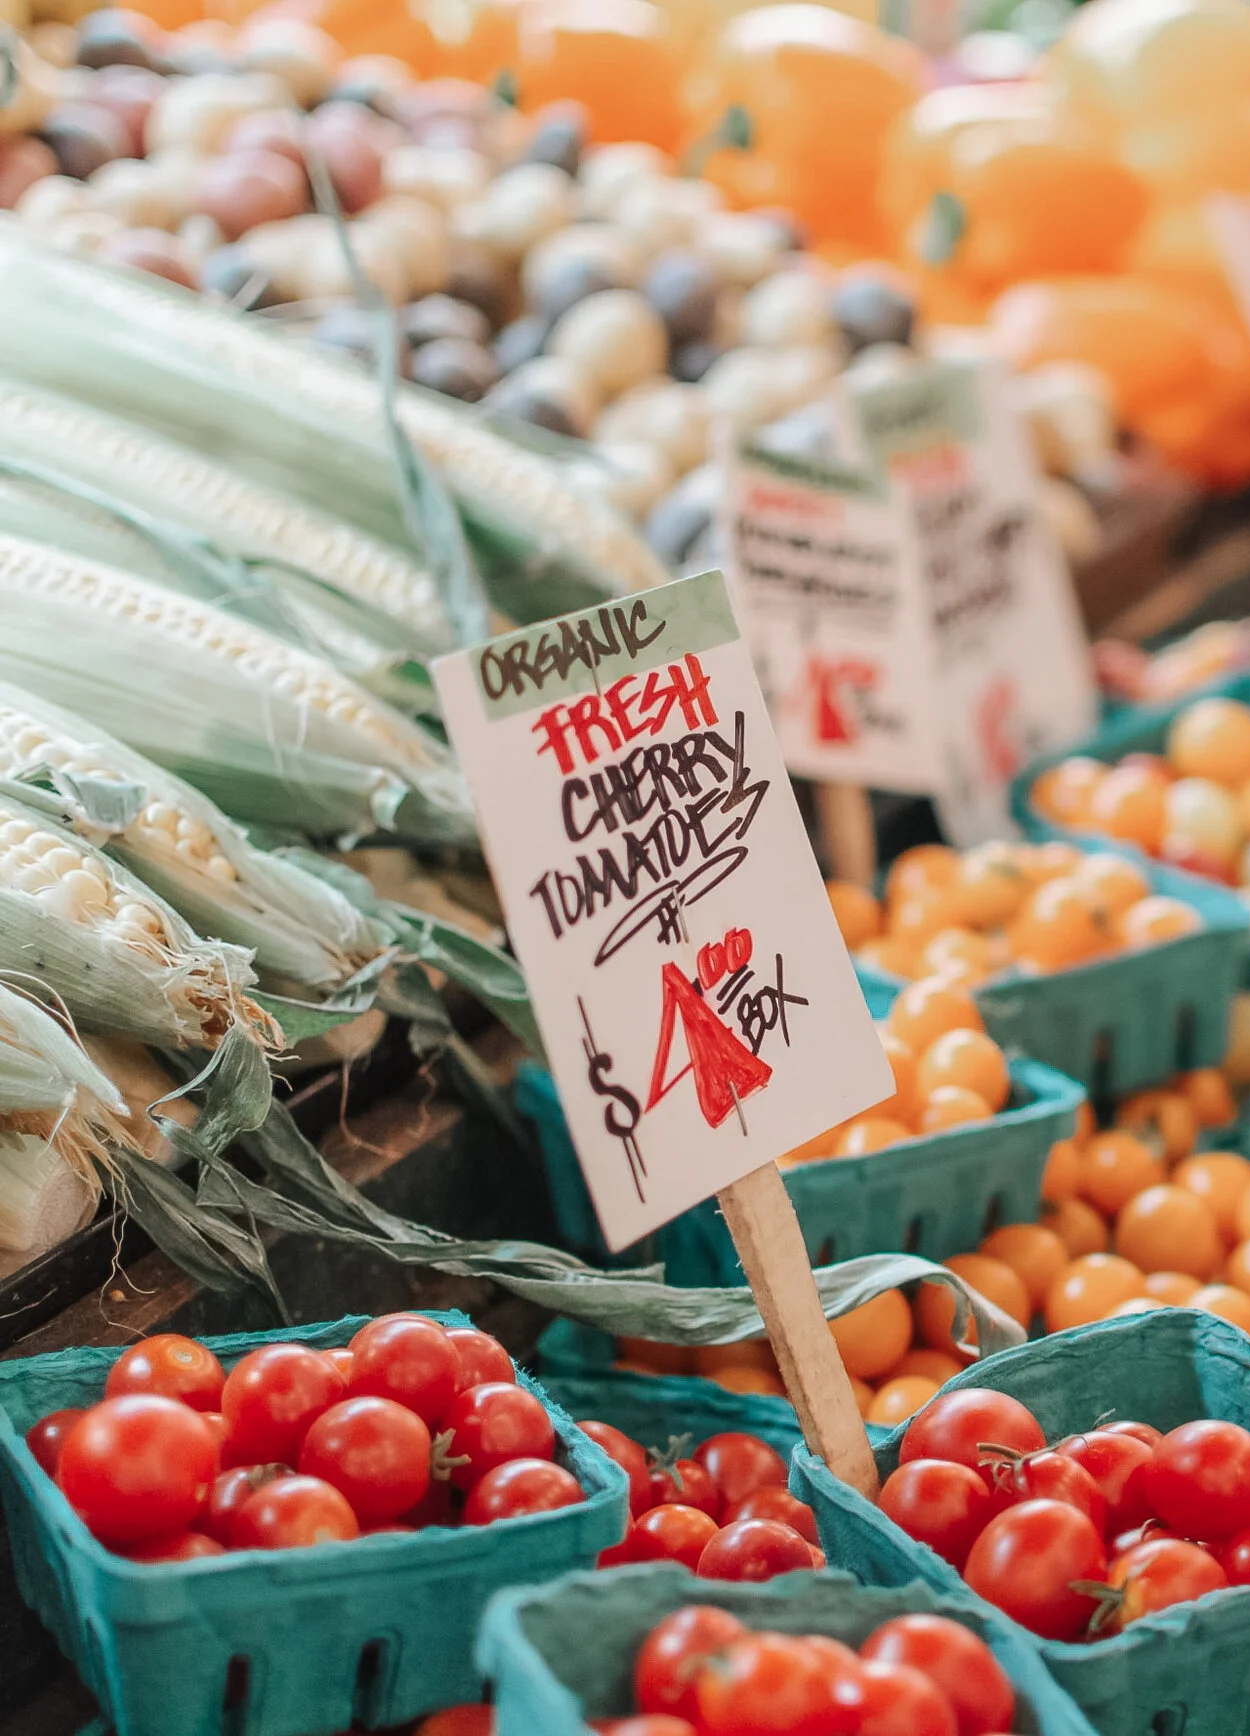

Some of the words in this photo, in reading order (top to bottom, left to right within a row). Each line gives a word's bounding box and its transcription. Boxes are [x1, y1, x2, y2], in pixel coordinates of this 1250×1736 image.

[480, 600, 666, 700] ORGANIC
[531, 653, 720, 776] FRESH
[562, 711, 746, 842] CHERRY
[530, 767, 770, 940] TOMATOES
[737, 953, 809, 1056] BOX
